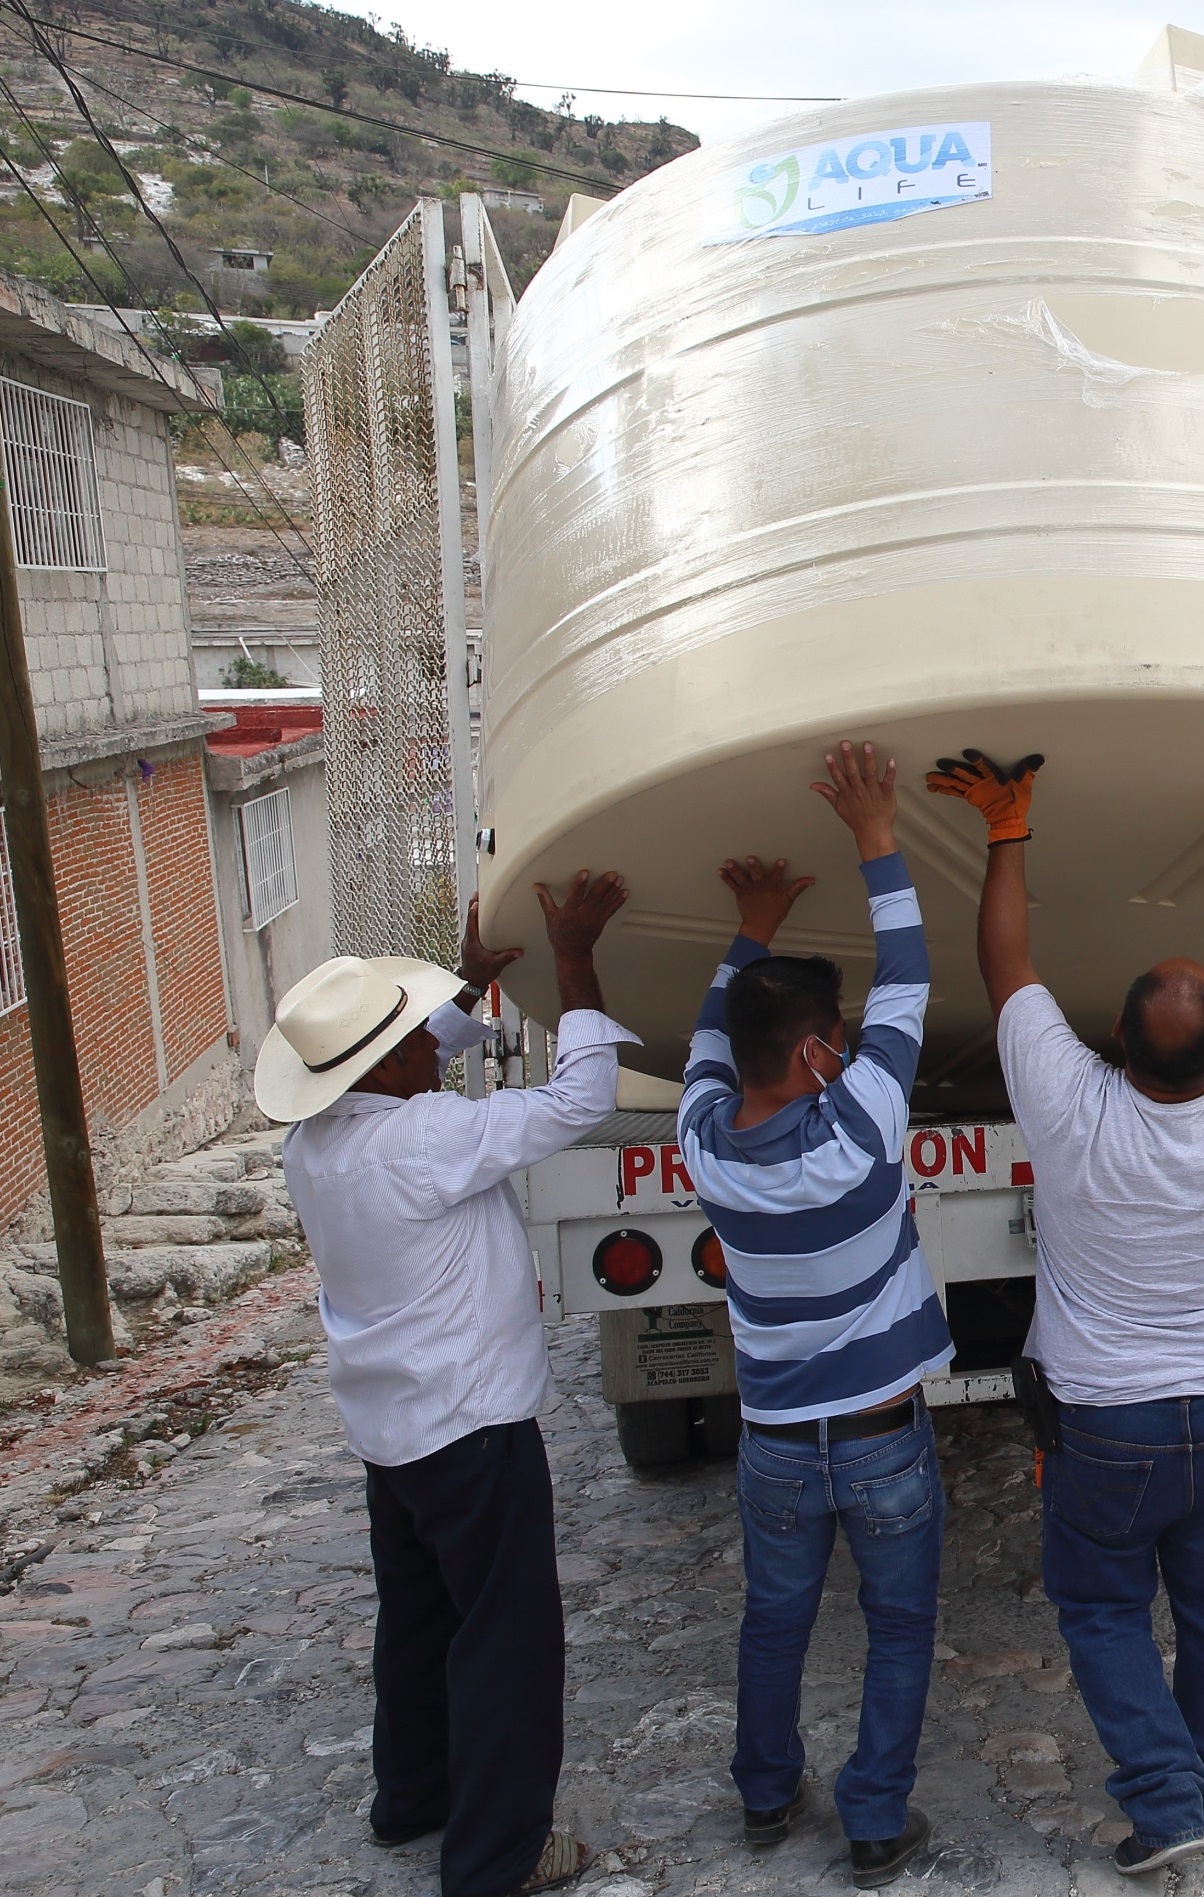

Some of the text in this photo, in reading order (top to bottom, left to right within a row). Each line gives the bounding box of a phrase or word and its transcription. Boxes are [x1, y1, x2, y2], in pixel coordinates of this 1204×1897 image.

[808, 131, 976, 191] AQUA
[808, 174, 976, 211] LIFE
[668, 1305, 704, 1317] California
[668, 1319, 703, 1330] Company
[686, 1351, 717, 1359] California
[657, 1370, 676, 1379] (744)
[677, 1369, 690, 1377] 317
[691, 1367, 709, 1376] 3053
